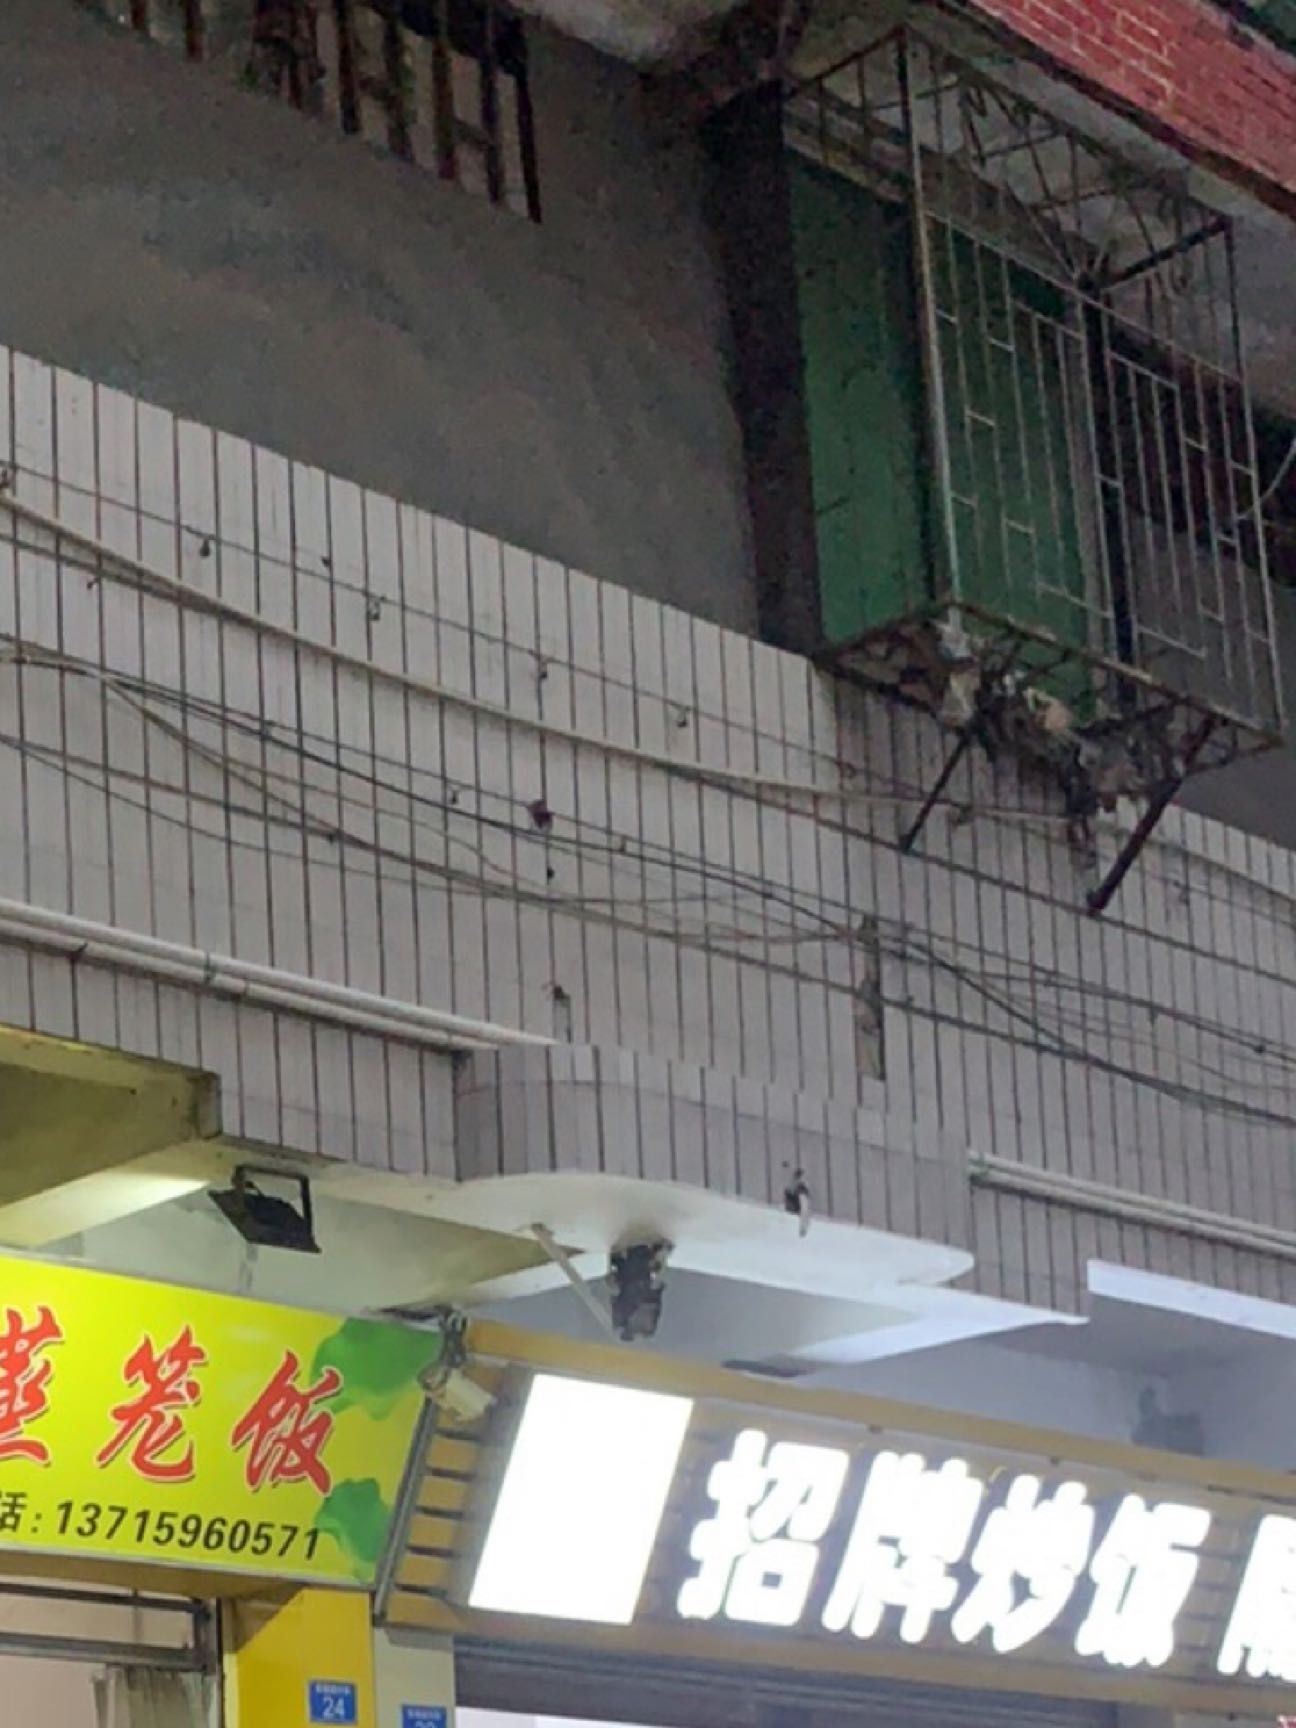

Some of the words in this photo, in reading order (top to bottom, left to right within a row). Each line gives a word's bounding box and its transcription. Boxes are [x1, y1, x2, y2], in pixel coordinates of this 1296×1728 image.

[677, 1428, 1211, 1668] 招牌炒饭
[322, 1696, 346, 1717] 24
